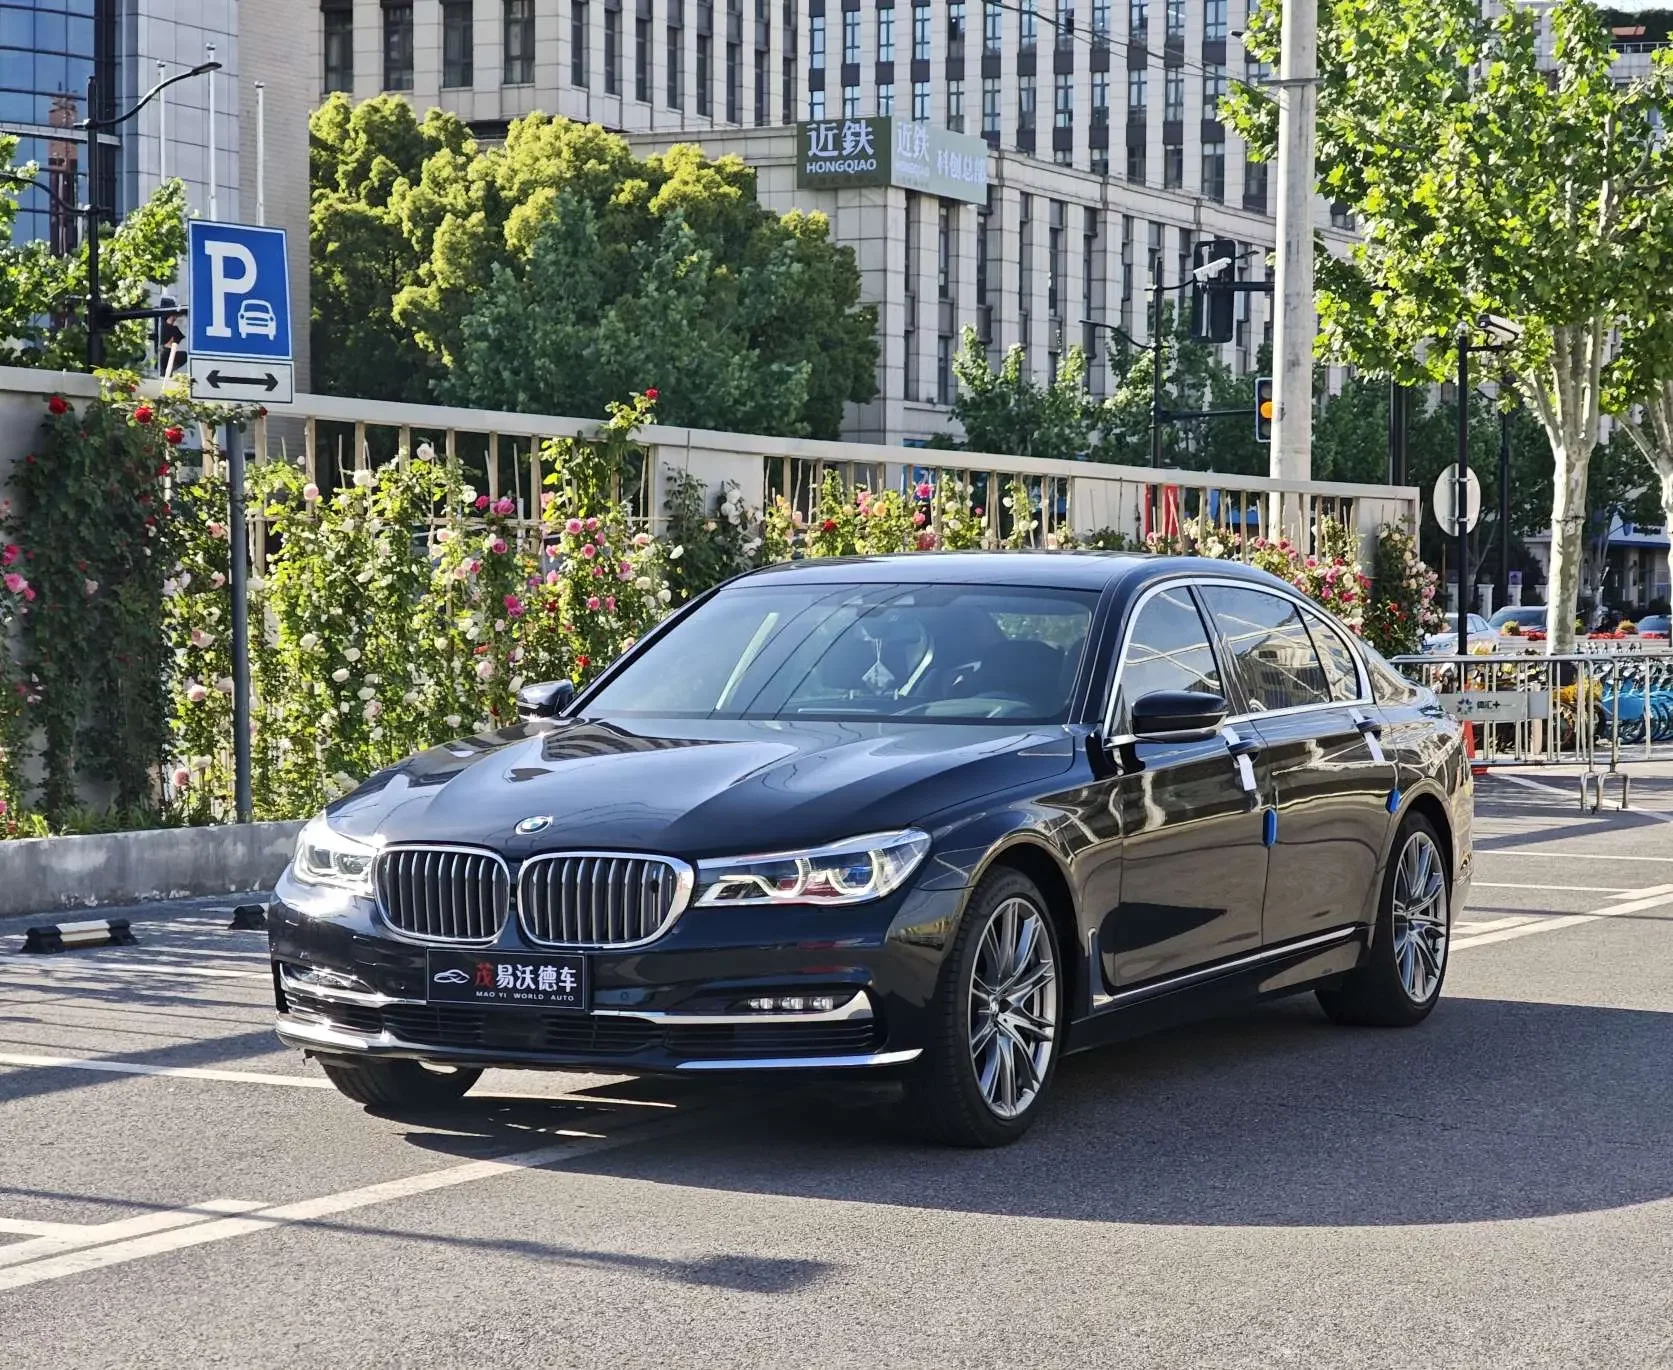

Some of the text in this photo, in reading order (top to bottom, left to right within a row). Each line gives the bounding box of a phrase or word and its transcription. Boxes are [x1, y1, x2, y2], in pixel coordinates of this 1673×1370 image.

[806, 158, 877, 174] HONGQIAO
[204, 239, 258, 338] P
[474, 961, 578, 993] 茂易沃德车
[513, 992, 545, 1000] WORLD
